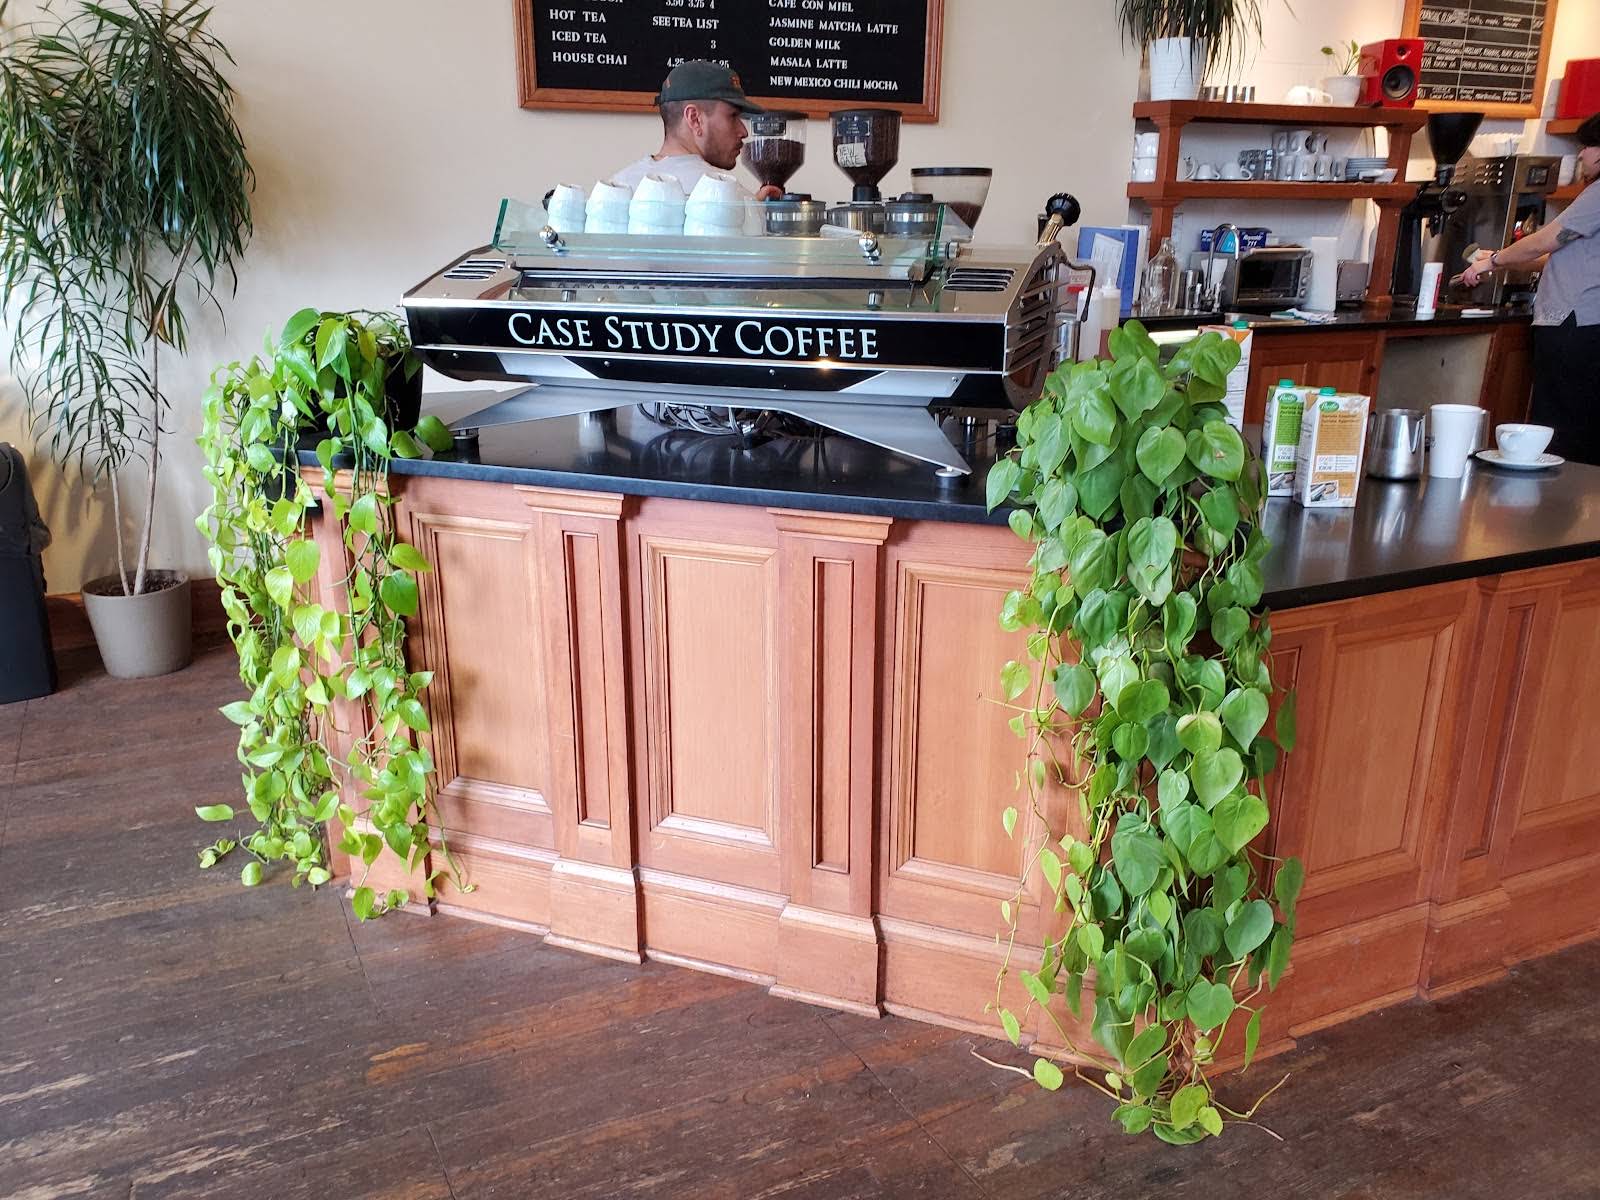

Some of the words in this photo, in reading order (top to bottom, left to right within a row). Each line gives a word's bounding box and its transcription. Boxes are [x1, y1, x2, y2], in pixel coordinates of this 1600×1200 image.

[802, 0, 824, 11] CON
[828, 2, 854, 13] MIEL
[549, 9, 576, 21] HOT
[582, 11, 607, 23] TEA
[652, 15, 671, 27] SEE
[672, 17, 693, 28] TEA
[696, 18, 719, 30] LIST
[769, 17, 814, 30] JASMINE
[819, 20, 862, 32] MATCHA
[867, 23, 899, 35] LATTE
[551, 30, 581, 42] ICED
[584, 32, 607, 44] TEA
[710, 39, 717, 49] 3
[768, 37, 812, 49] GOLDEN
[815, 39, 841, 50] MILK
[552, 52, 594, 64] HOUSE
[597, 54, 628, 65] CHAI
[770, 56, 812, 68] MASALA
[816, 58, 848, 70] LATTE
[770, 75, 793, 87] NEW
[794, 77, 832, 88] MEXICO
[834, 78, 861, 89] CHILI
[863, 80, 899, 91] MOCHA
[507, 312, 594, 347] CASE
[604, 315, 723, 353] STUDY
[735, 320, 879, 359] COFFEE
